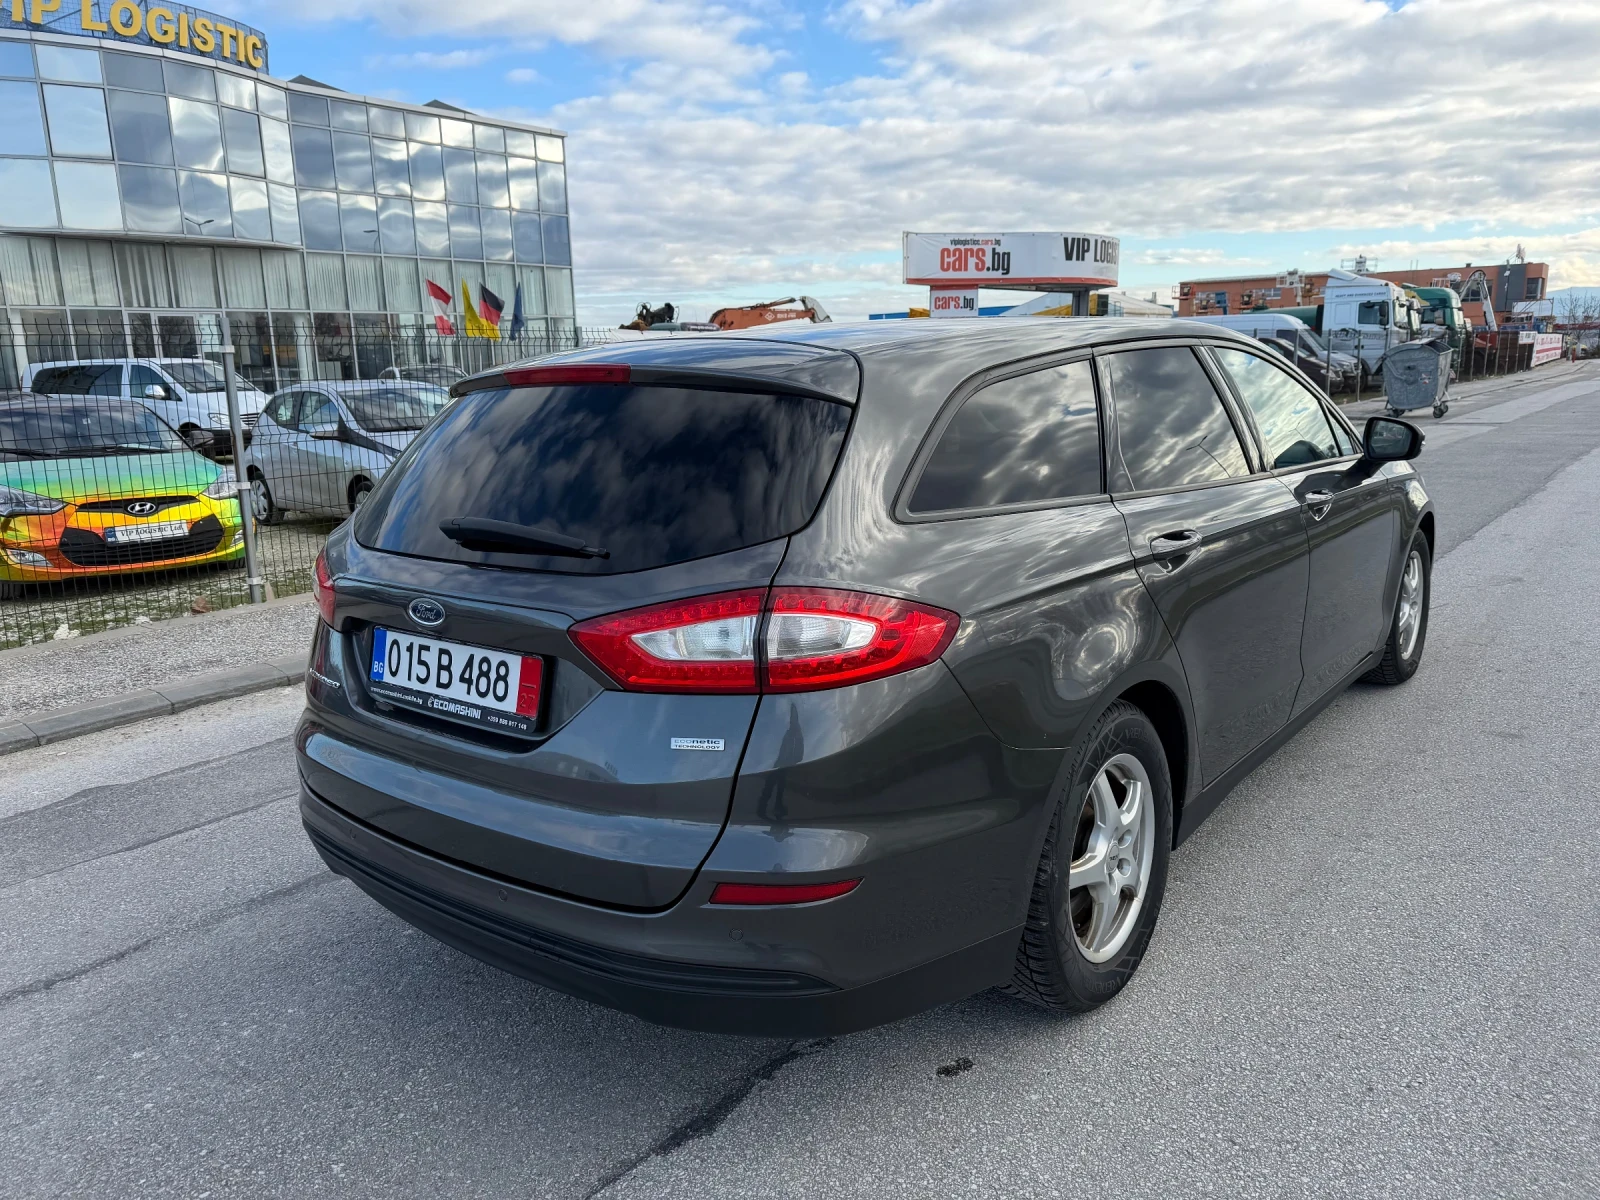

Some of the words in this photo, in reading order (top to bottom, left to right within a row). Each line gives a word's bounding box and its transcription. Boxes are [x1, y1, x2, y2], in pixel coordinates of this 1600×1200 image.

[81, 0, 263, 68] LOGISTIC
[940, 247, 1011, 275] cars.bg
[1063, 237, 1091, 262] VIP
[934, 295, 974, 310] cars.bg
[373, 660, 384, 674] BG
[433, 698, 482, 720] ECOMASHINI
